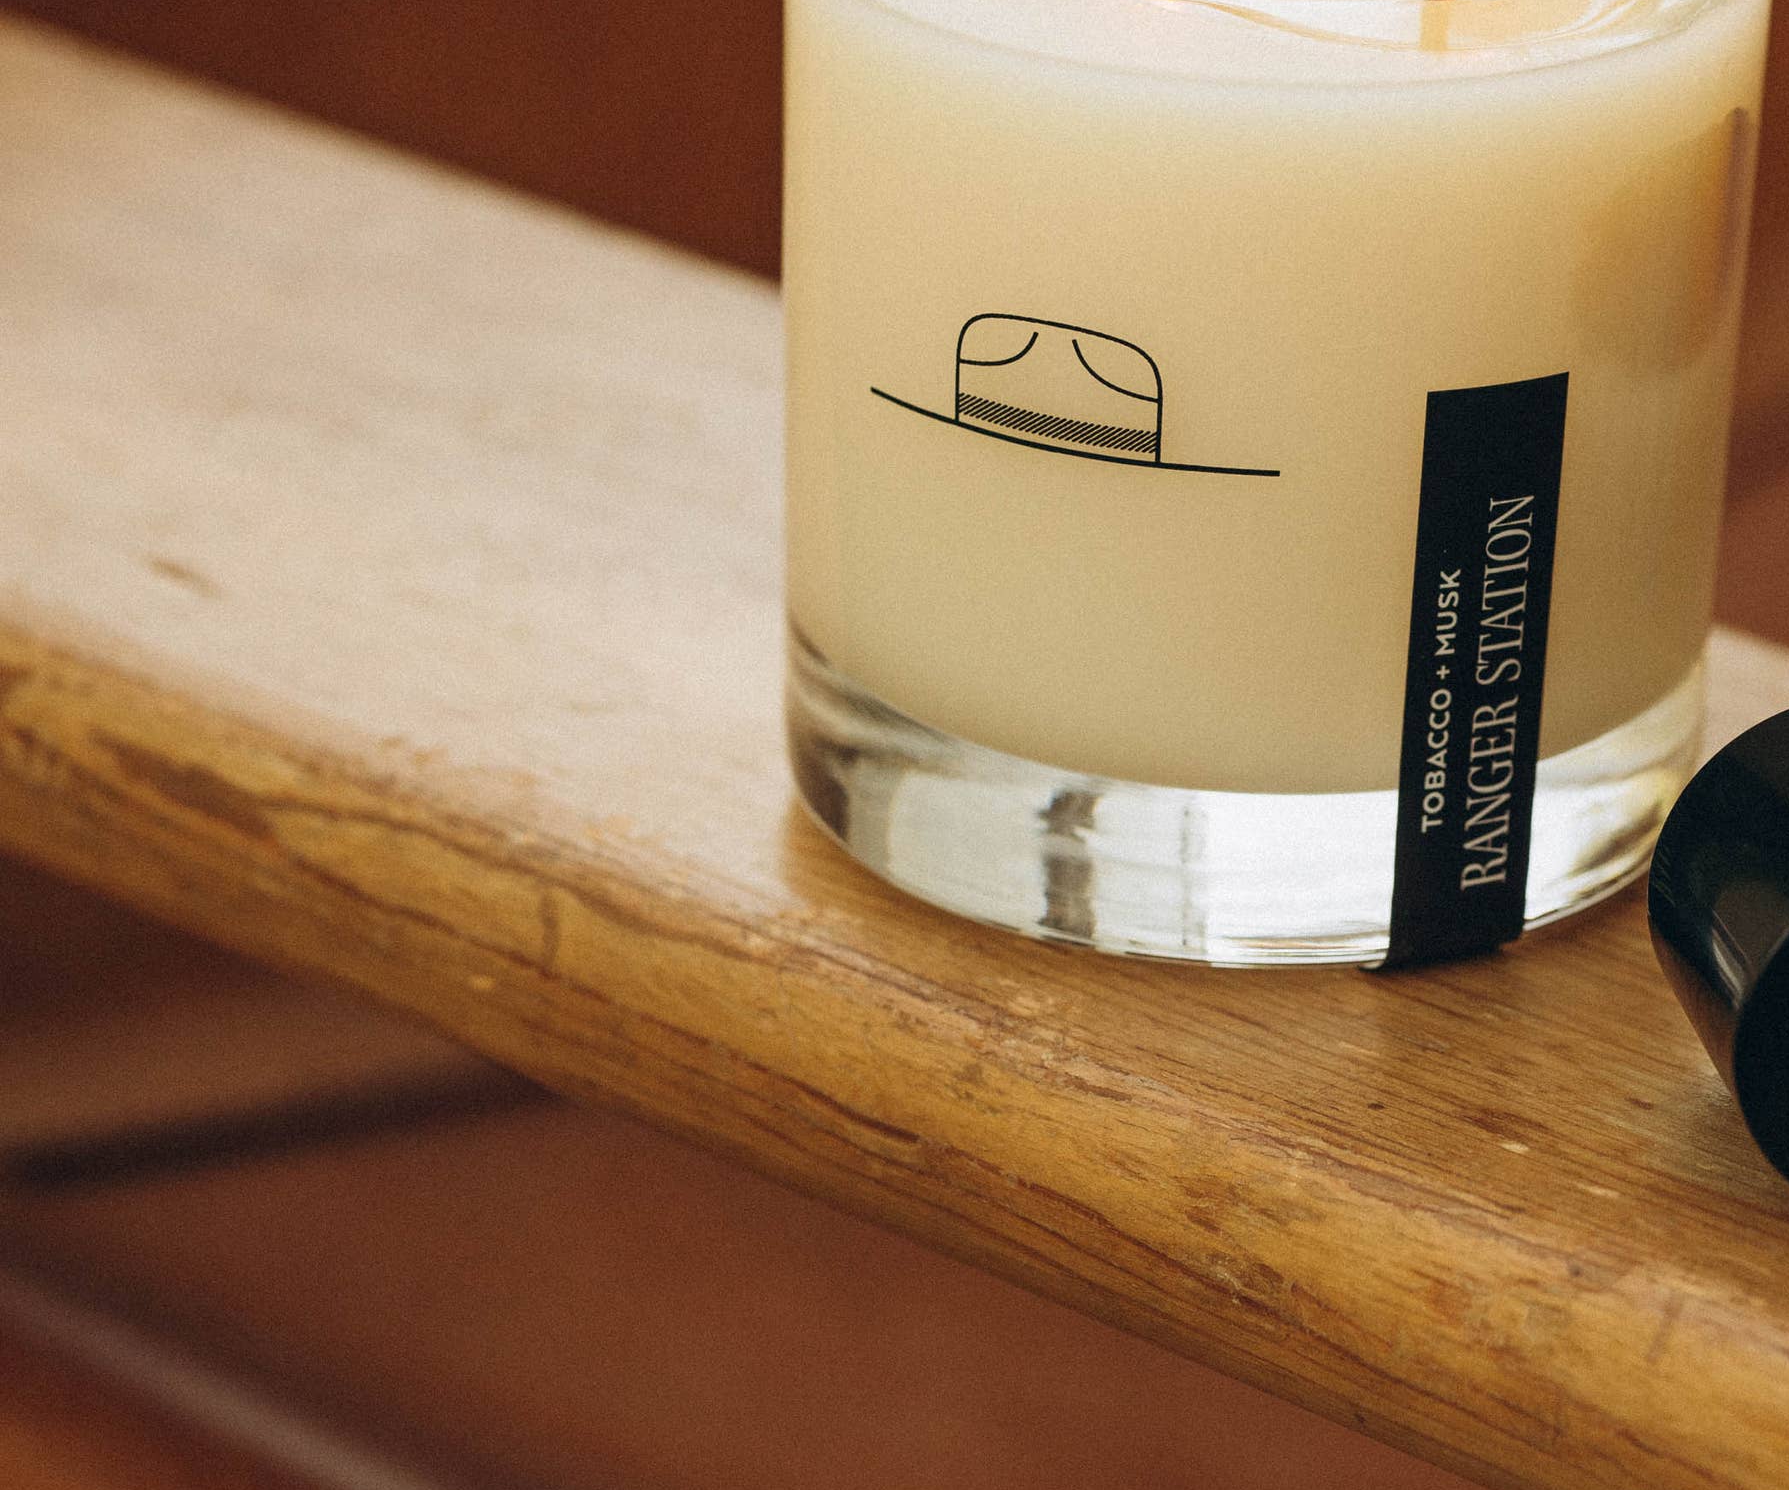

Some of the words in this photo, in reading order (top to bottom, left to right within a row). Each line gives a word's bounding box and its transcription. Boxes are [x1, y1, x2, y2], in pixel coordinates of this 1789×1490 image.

[1435, 568, 1461, 656] MUSK
[1475, 495, 1535, 685] STATION
[1436, 665, 1450, 680] +
[1420, 688, 1452, 834] TOBACCO
[1460, 693, 1519, 891] RANGER
